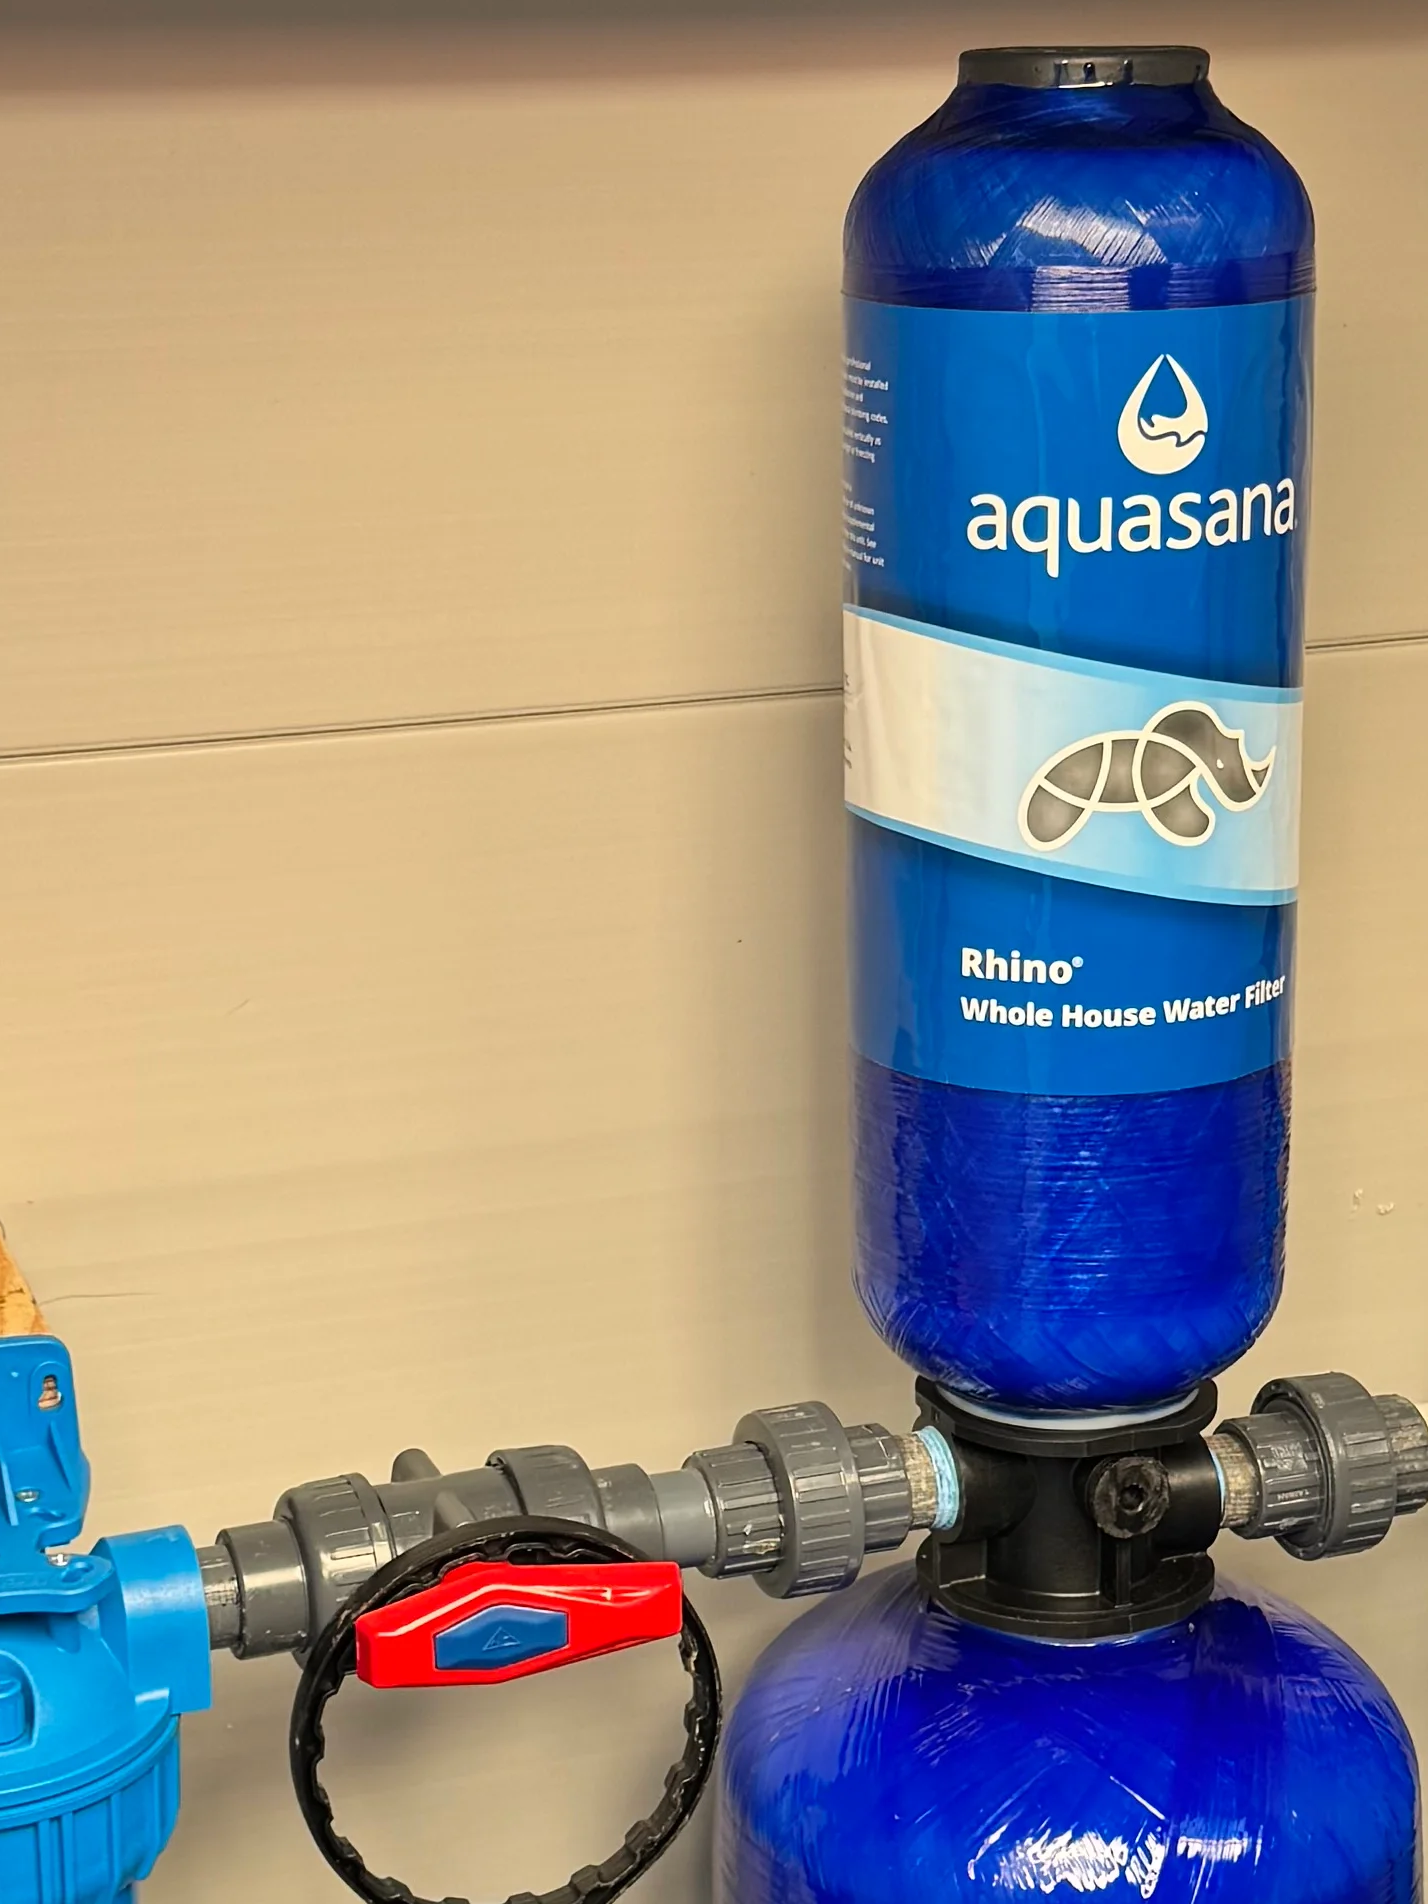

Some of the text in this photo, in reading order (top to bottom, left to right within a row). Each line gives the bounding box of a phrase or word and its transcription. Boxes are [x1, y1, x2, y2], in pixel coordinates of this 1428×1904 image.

[967, 477, 1296, 578] aquasana
[960, 973, 1286, 1028] Whole House Water Filter
